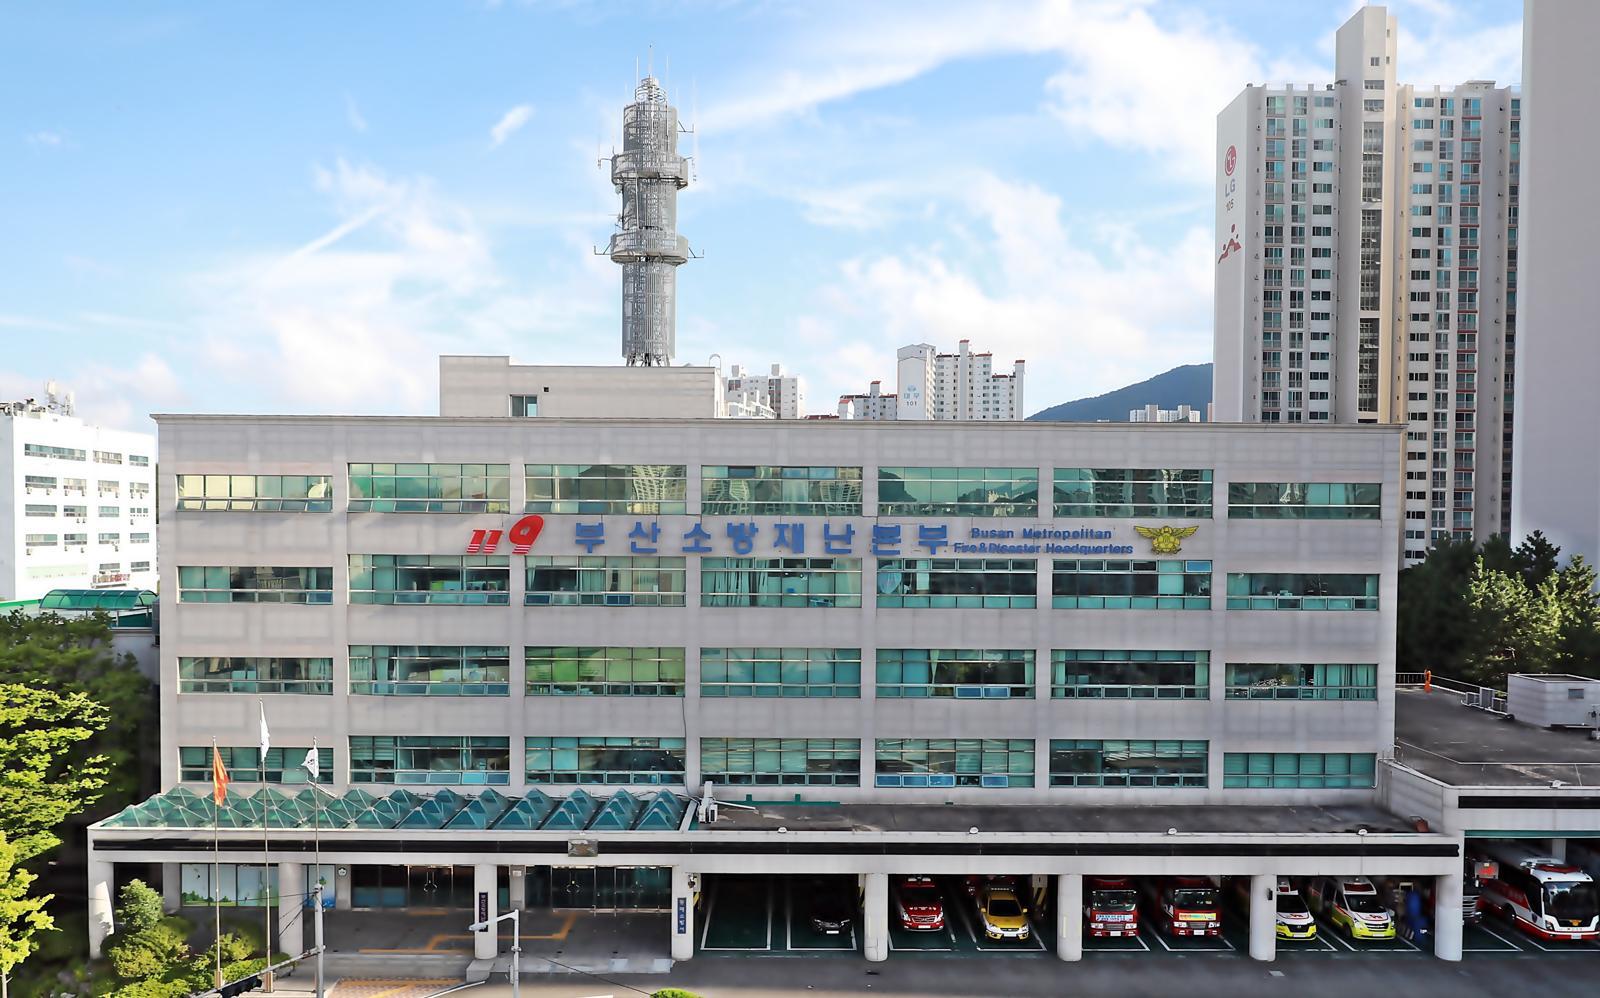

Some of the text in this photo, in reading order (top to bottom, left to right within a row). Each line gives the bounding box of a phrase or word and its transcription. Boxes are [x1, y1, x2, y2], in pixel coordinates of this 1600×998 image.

[1225, 178, 1236, 197] LG
[466, 514, 948, 555] 119 부산소방재난본부
[971, 527, 1112, 540] Busan Metropolitan
[1046, 543, 1133, 555] Headquarters
